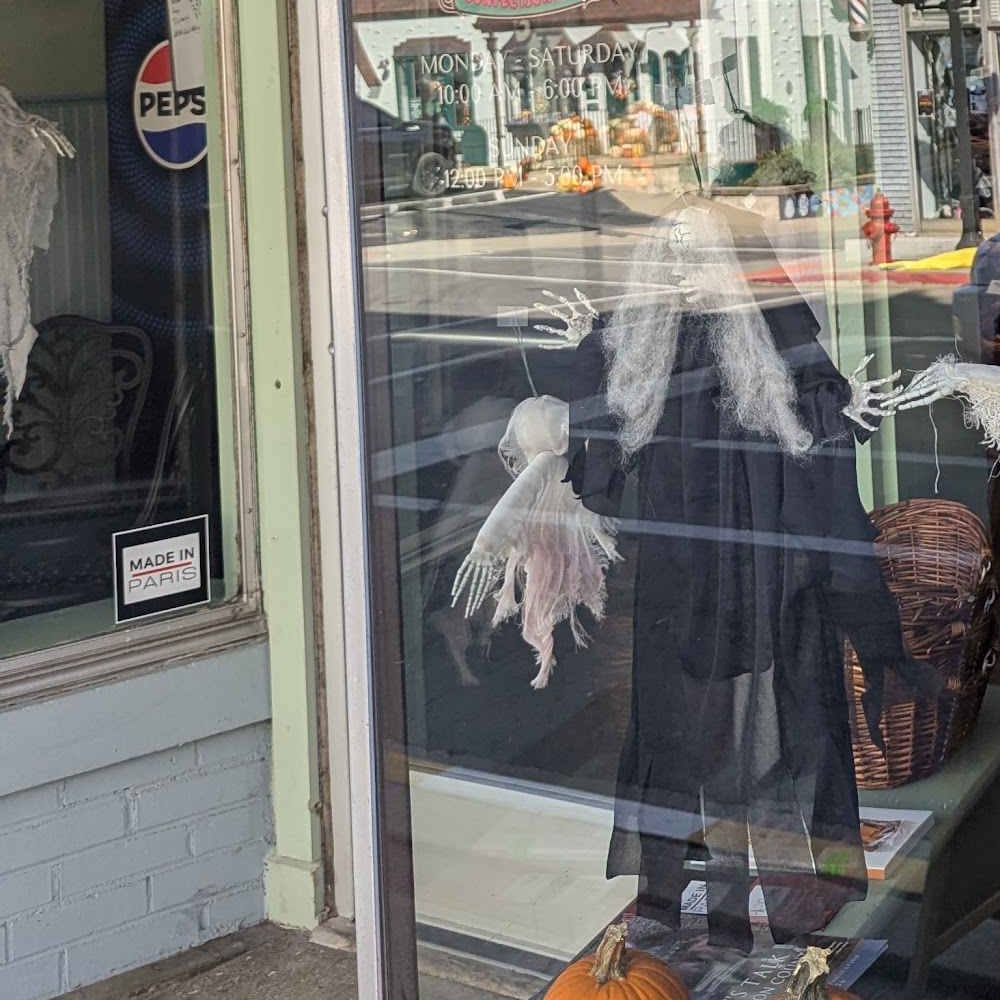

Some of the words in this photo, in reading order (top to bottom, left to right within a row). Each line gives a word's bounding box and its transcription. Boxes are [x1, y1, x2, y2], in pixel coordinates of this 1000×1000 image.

[421, 52, 509, 75] MONDAY
[529, 41, 639, 68] SATURDAY
[437, 83, 482, 105] 10:00
[489, 83, 521, 103] AM
[543, 77, 583, 100] 6:00
[592, 75, 623, 97] PM
[139, 90, 207, 118] PEPS
[489, 134, 573, 158] SUNDAY
[443, 168, 487, 189] 12:00
[494, 167, 523, 188] PM
[544, 165, 583, 187] 5:00
[592, 164, 623, 185] PM
[130, 551, 175, 572] MADE
[180, 547, 195, 561] IN
[128, 566, 197, 593] PARIS
[680, 892, 702, 911] MADE
[740, 954, 790, 987] TALK
